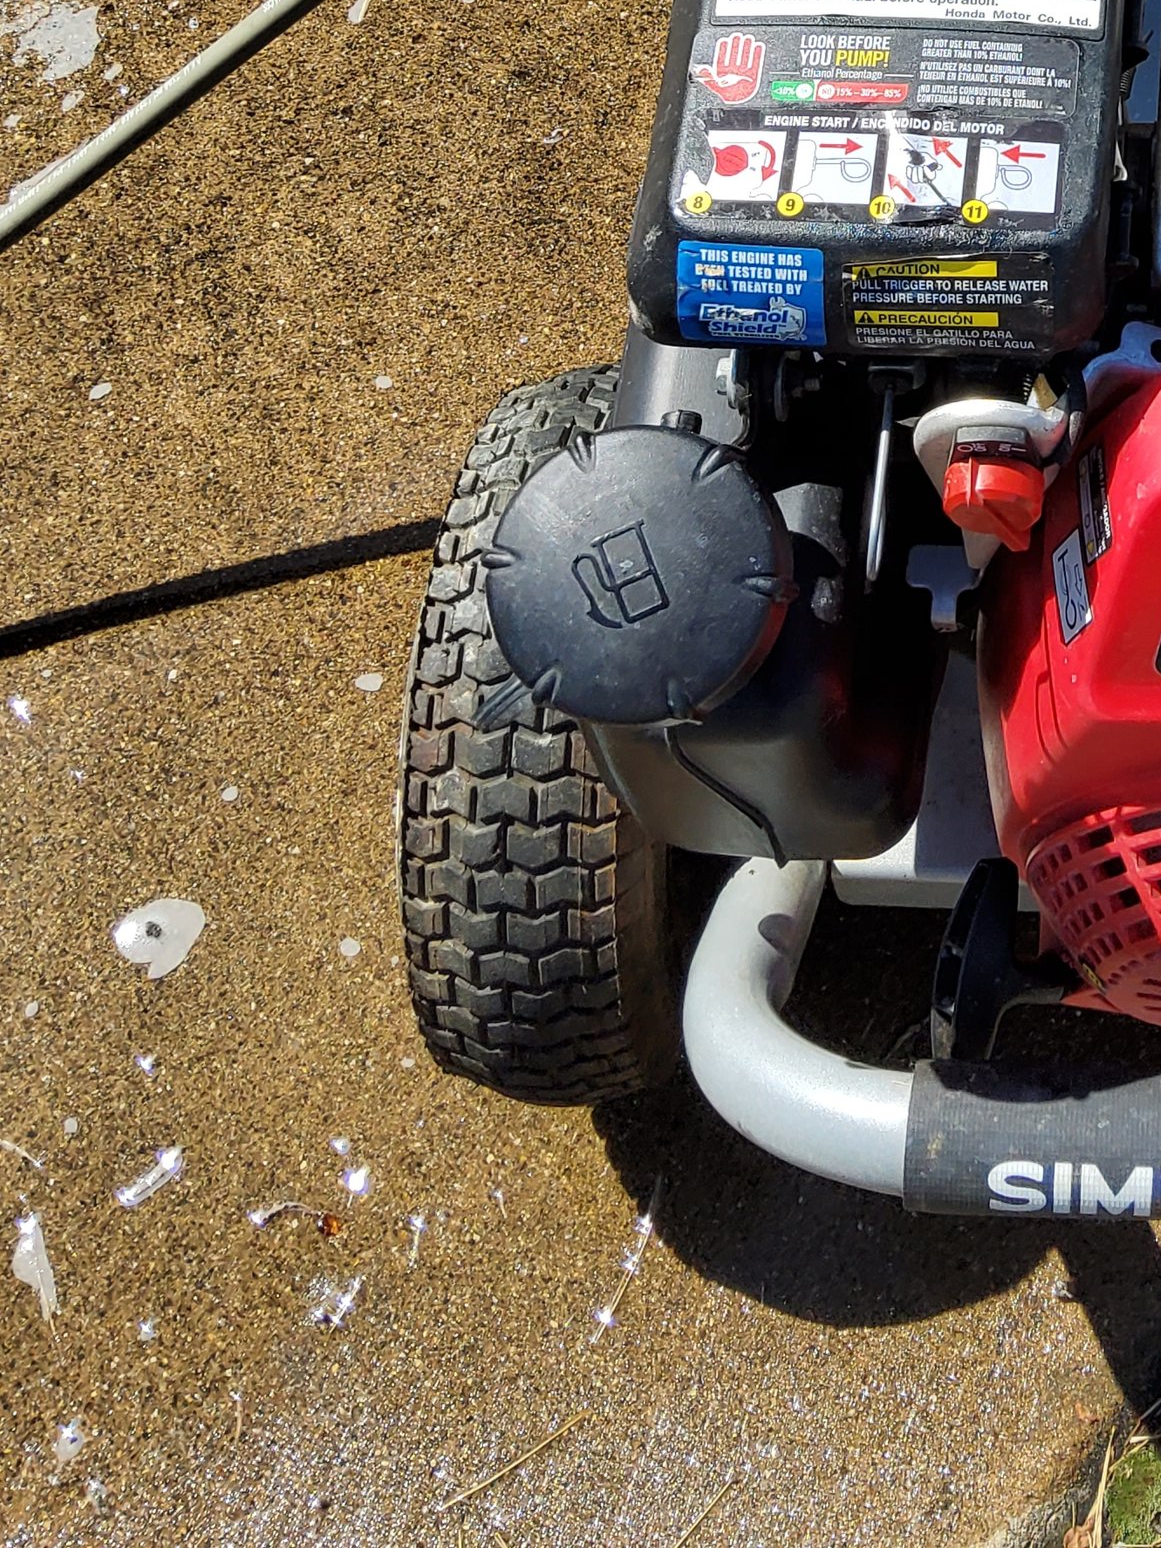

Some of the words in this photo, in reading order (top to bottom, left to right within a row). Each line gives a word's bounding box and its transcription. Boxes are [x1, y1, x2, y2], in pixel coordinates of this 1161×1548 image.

[945, 8, 985, 19] Honda
[993, 10, 1031, 21] Motor
[1038, 13, 1062, 25] Co.,
[1069, 15, 1092, 27] Ltd.
[800, 34, 835, 49] LOOK
[838, 35, 891, 50] BEFORE
[923, 39, 933, 48] DO
[934, 39, 948, 48] NOT
[950, 40, 963, 49] USE
[964, 41, 980, 50] FUEL
[982, 42, 1023, 51] CONTAINING
[800, 50, 832, 66] YOU
[835, 50, 890, 68] PUMP!
[922, 48, 952, 58] GREATER
[954, 49, 972, 59] THAN
[974, 50, 988, 59] 10%
[989, 51, 1023, 62] ETHANOL!
[801, 67, 834, 78] Ethanol
[835, 69, 883, 81] Percentage
[920, 61, 957, 72] N'UTILISEZ
[958, 63, 972, 72] PAS
[984, 64, 1026, 75] CARBURANT
[1026, 66, 1046, 77] DONT
[920, 71, 946, 80] TENEUR
[990, 75, 1003, 84] EST
[1054, 78, 1071, 89] 10%!
[836, 87, 853, 97] 15%
[931, 85, 958, 95] UTILICE
[959, 86, 1011, 97] COMBUSTIBLES
[1012, 88, 1026, 98] QUE
[917, 94, 958, 104] CONTENGAN
[959, 93, 975, 105] MÁS
[987, 97, 1001, 107] 10%
[1014, 98, 1043, 109] ETANOL!
[765, 115, 809, 126] ENGINE
[812, 116, 850, 128] START
[861, 118, 930, 130] ENCNDIDO
[934, 120, 957, 133] DEL
[960, 123, 1004, 135] MOTOR
[693, 195, 704, 209] 8
[785, 198, 796, 212] 9
[873, 202, 892, 215] 10
[966, 205, 983, 219] 11
[700, 249, 729, 263] THIS
[731, 251, 775, 265] ENGINE
[778, 254, 802, 267] HAS
[728, 266, 771, 280] TESTED
[775, 269, 808, 282] WITH
[876, 263, 940, 277] CAUTION
[701, 279, 729, 292] FUEL
[731, 280, 783, 294] TREATED
[786, 283, 802, 295] BY
[852, 280, 883, 290] PULL
[884, 280, 934, 291] TRIGGER
[935, 280, 950, 291] TO
[954, 280, 1007, 291] RELEASE
[1009, 280, 1049, 292] WATER
[853, 293, 914, 303] PRESSURE
[917, 293, 963, 304] BEFORE
[966, 293, 1022, 305] STARTING
[878, 312, 974, 325] PRECAUCIÓN
[710, 321, 778, 334] Shield
[855, 327, 912, 337] PRESIONE
[916, 329, 930, 338] EL
[933, 329, 980, 339] GATILLO
[982, 330, 1013, 340] PARA
[857, 337, 906, 345] LIBERAR
[909, 337, 924, 345] LA
[979, 339, 1002, 349] DEL
[1004, 341, 1035, 350] AGUA
